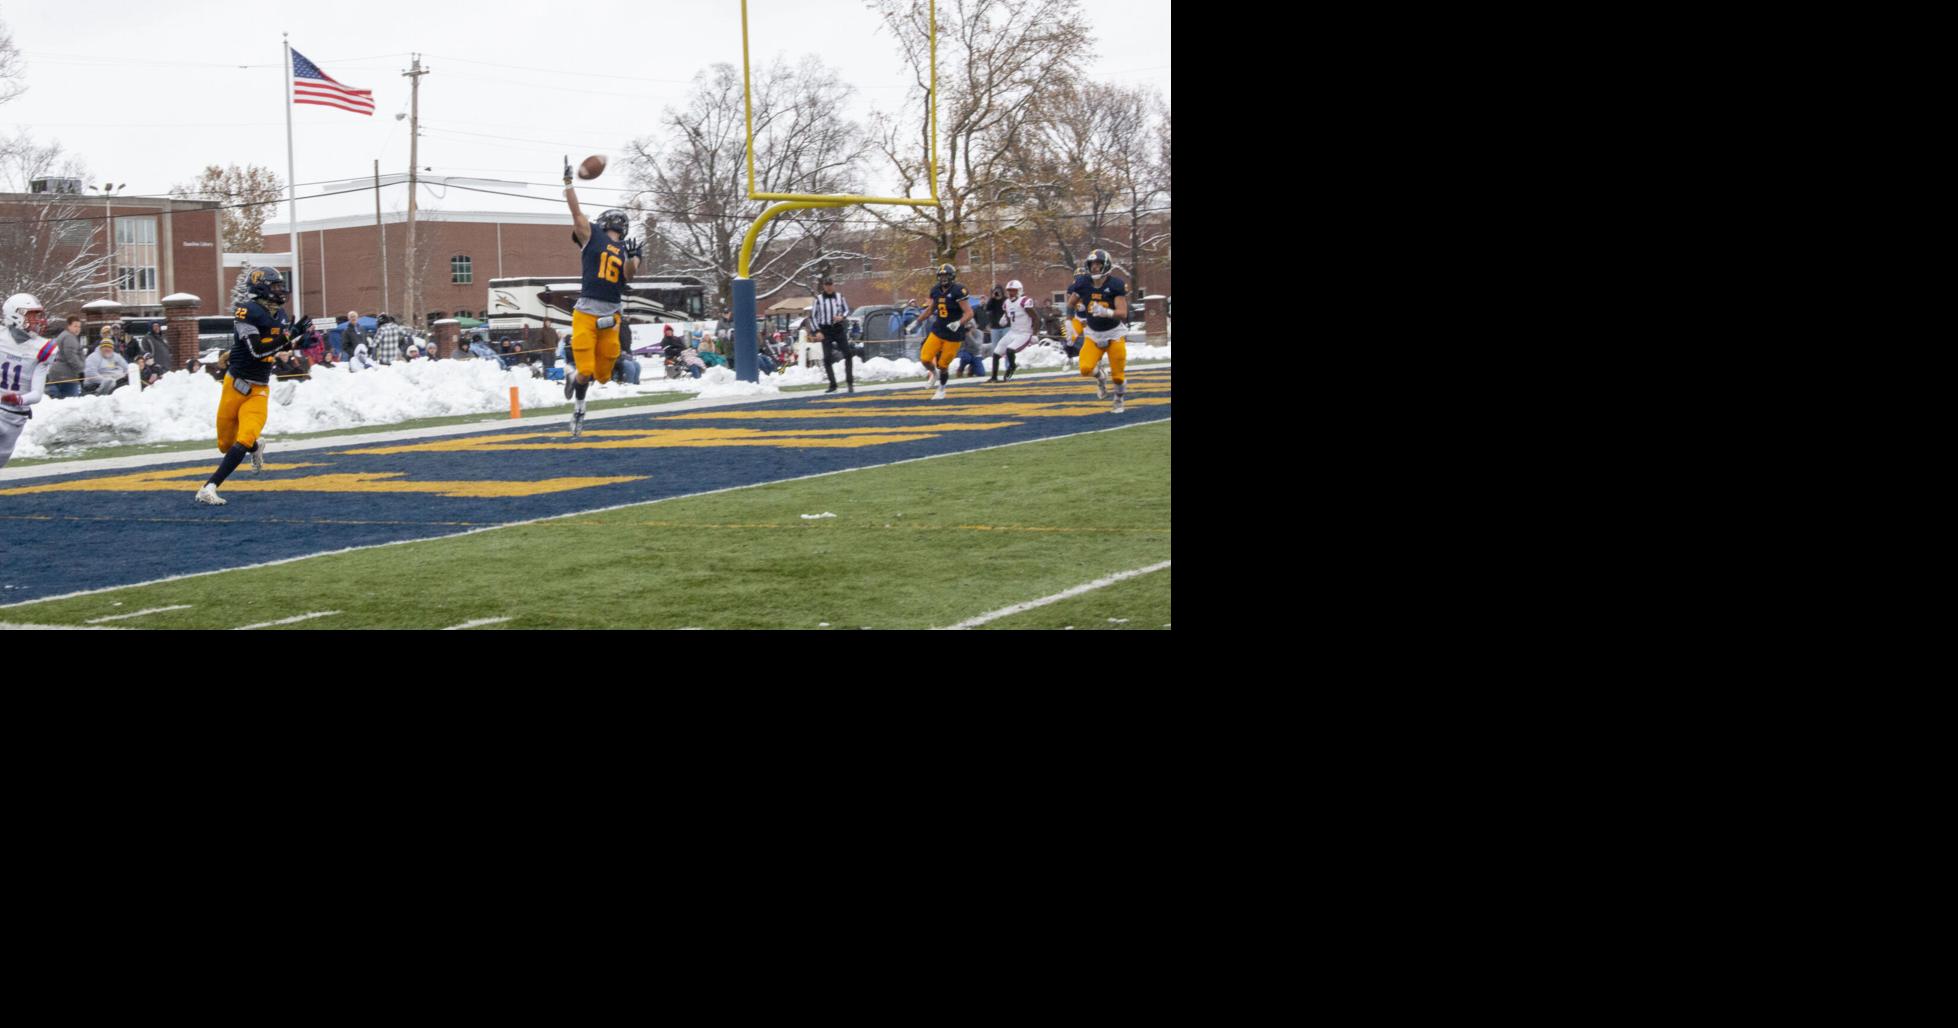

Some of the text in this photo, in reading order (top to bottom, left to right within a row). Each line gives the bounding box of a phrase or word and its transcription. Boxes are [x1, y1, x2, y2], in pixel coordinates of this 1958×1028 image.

[598, 251, 622, 284] 16
[235, 306, 249, 320] 22
[0, 361, 22, 391] 11
